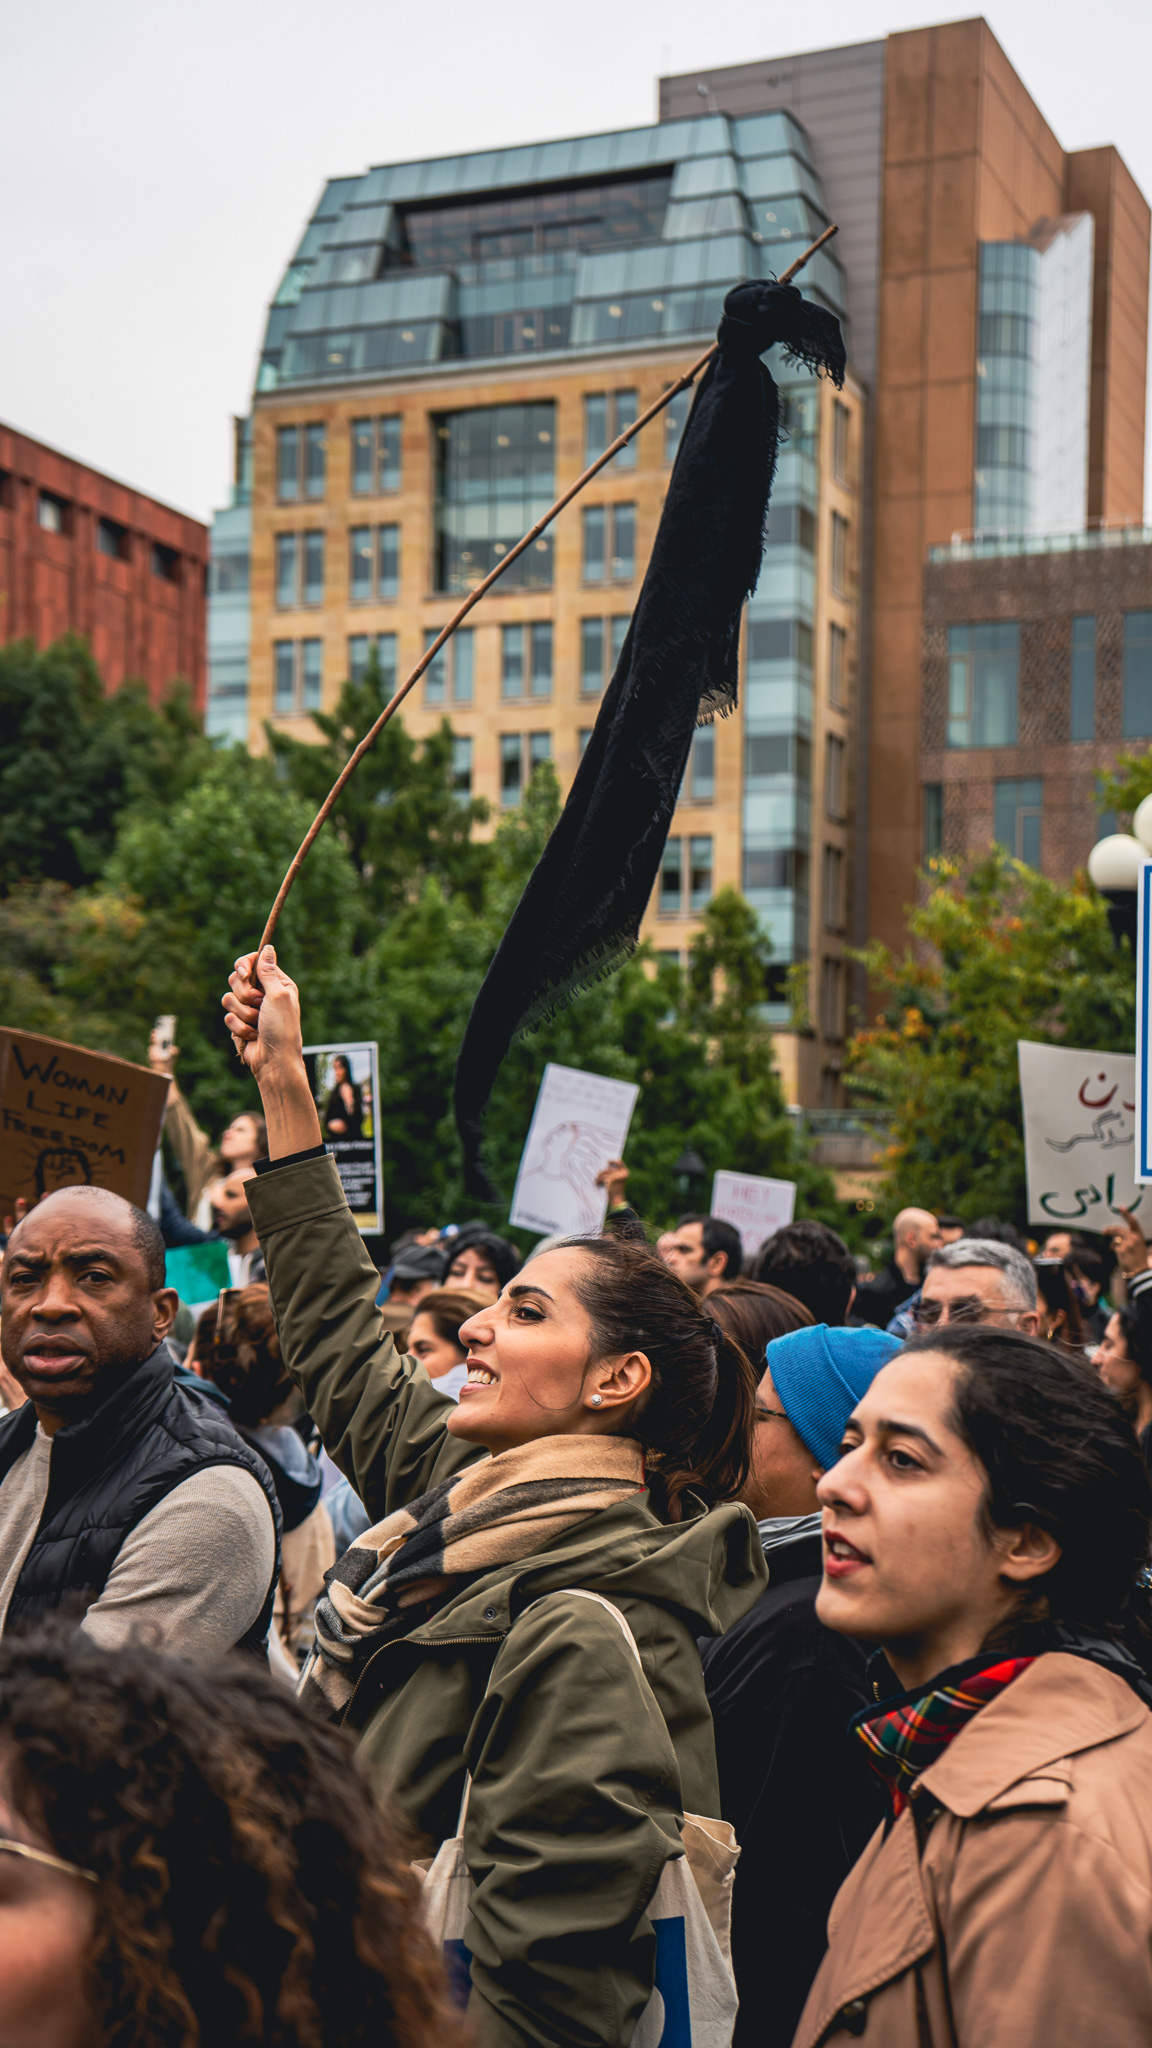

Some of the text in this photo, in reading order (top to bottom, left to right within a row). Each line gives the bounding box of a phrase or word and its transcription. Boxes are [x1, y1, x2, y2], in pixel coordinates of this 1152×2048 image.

[12, 1044, 129, 1105] WOMAN
[2, 1108, 125, 1165] FREEDOM
[26, 1089, 109, 1129] LIFE
